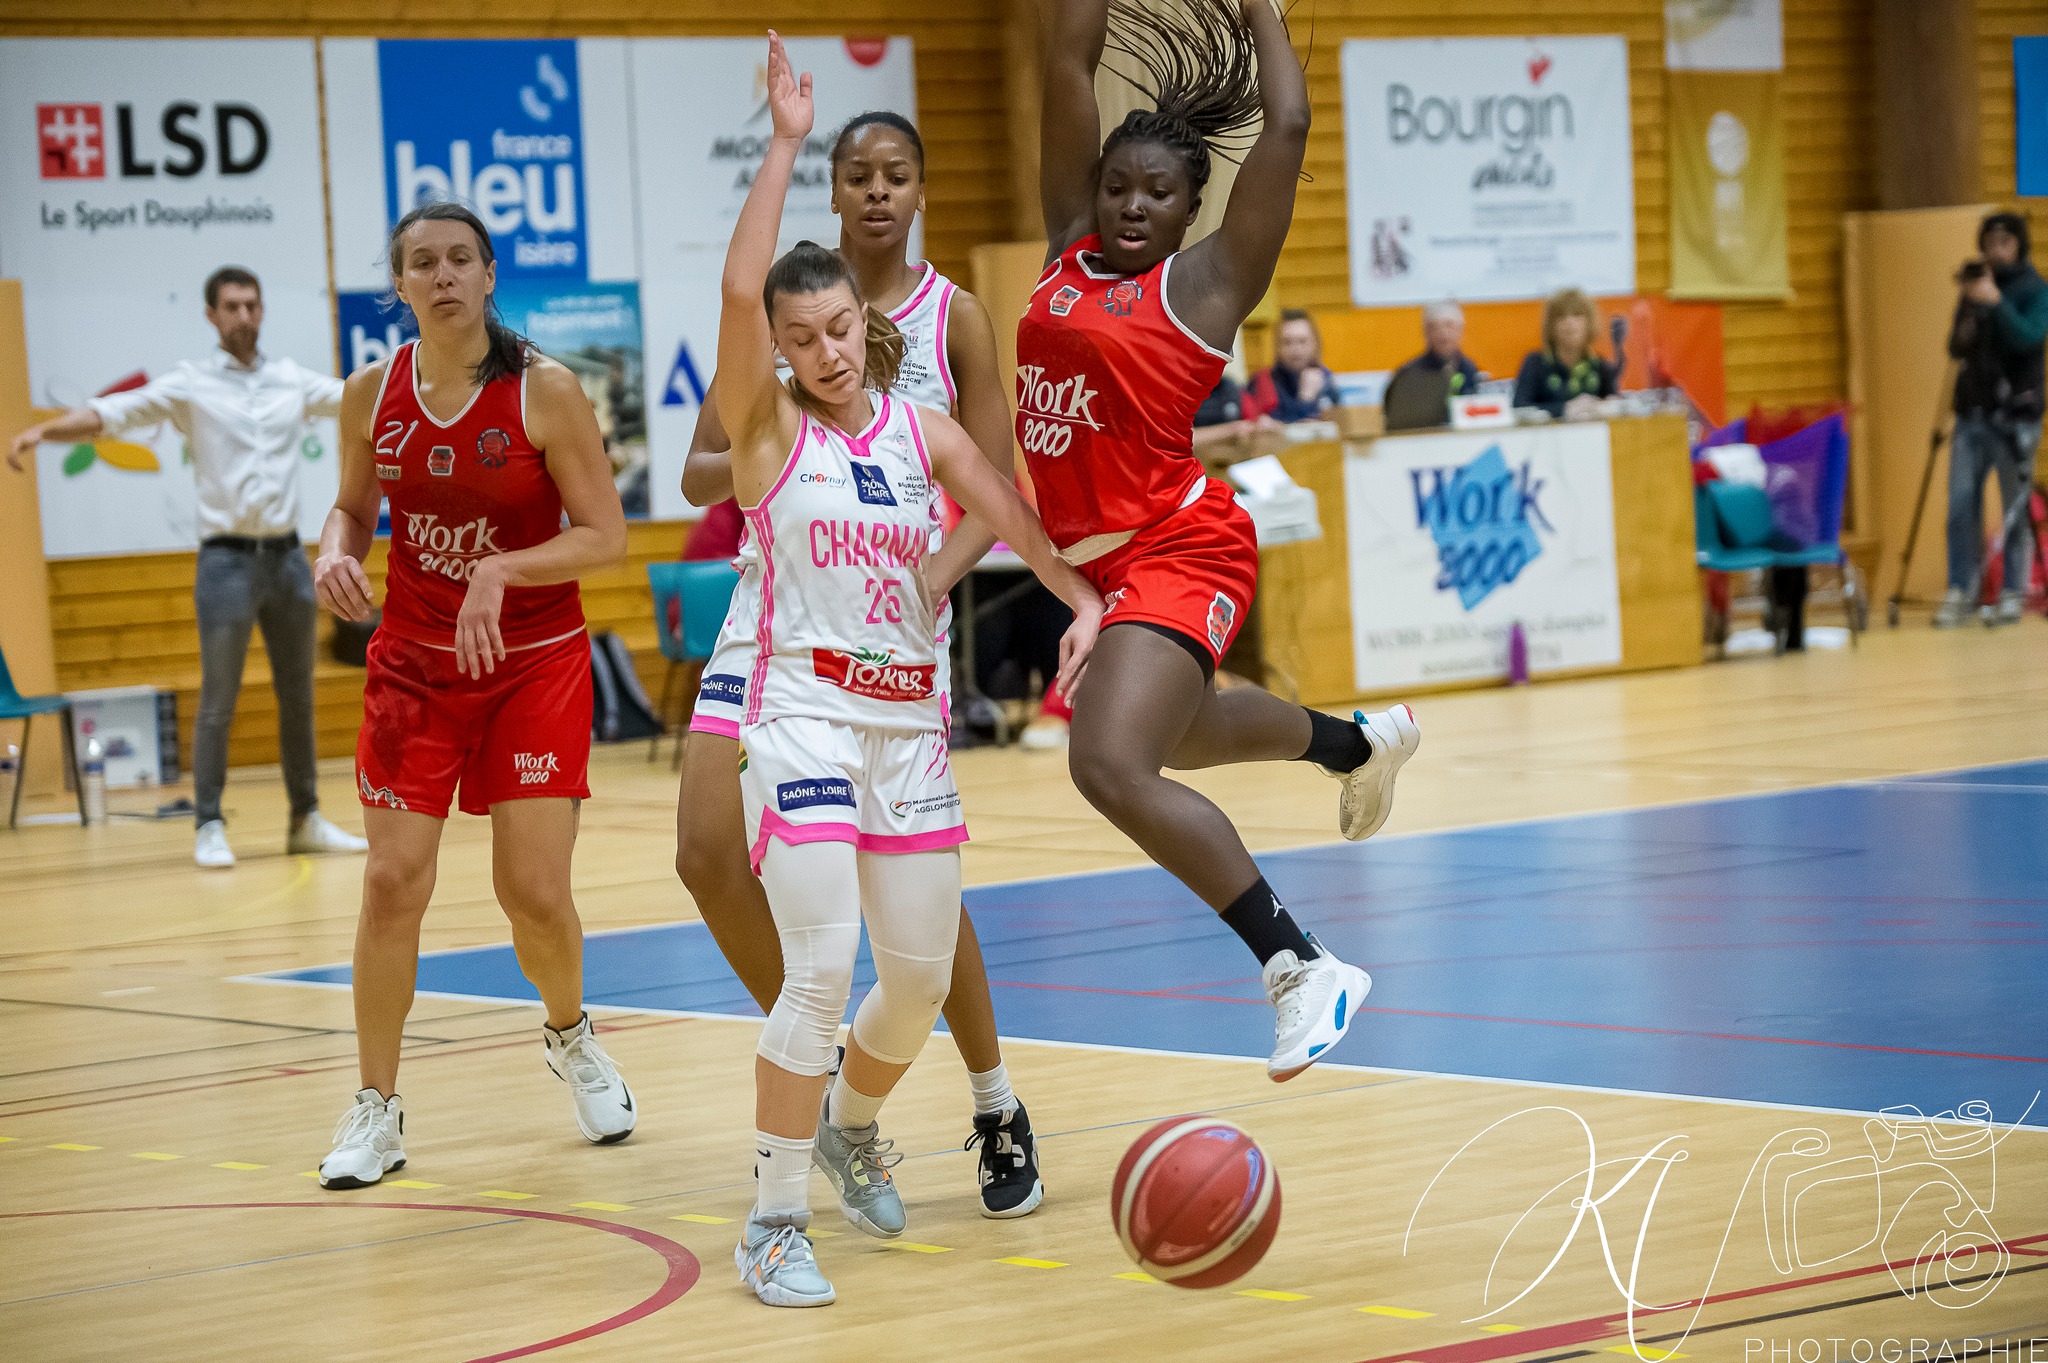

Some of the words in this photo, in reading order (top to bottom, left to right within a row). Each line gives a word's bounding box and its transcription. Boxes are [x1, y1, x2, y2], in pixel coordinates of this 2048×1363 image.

[1386, 82, 1575, 153] Bourgin
[115, 102, 269, 177] LSD
[491, 128, 573, 159] france
[394, 139, 577, 234] bleu
[41, 201, 67, 230] Le
[76, 199, 137, 234] Sport
[144, 196, 274, 233] Dauphinois
[513, 235, 578, 267] isère
[1017, 364, 1100, 431] Work
[375, 419, 420, 459] 21
[1024, 418, 1073, 458] 2000
[799, 473, 847, 487] Charnay
[1409, 461, 1557, 535] Work
[402, 511, 503, 554] Work
[1436, 537, 1526, 590] 2000
[864, 577, 903, 625] 25
[728, 683, 744, 696] LOI
[513, 751, 560, 772] Work
[520, 770, 550, 785] 2000
[782, 786, 816, 801] SAÔNE
[822, 785, 848, 796] LOIRE
